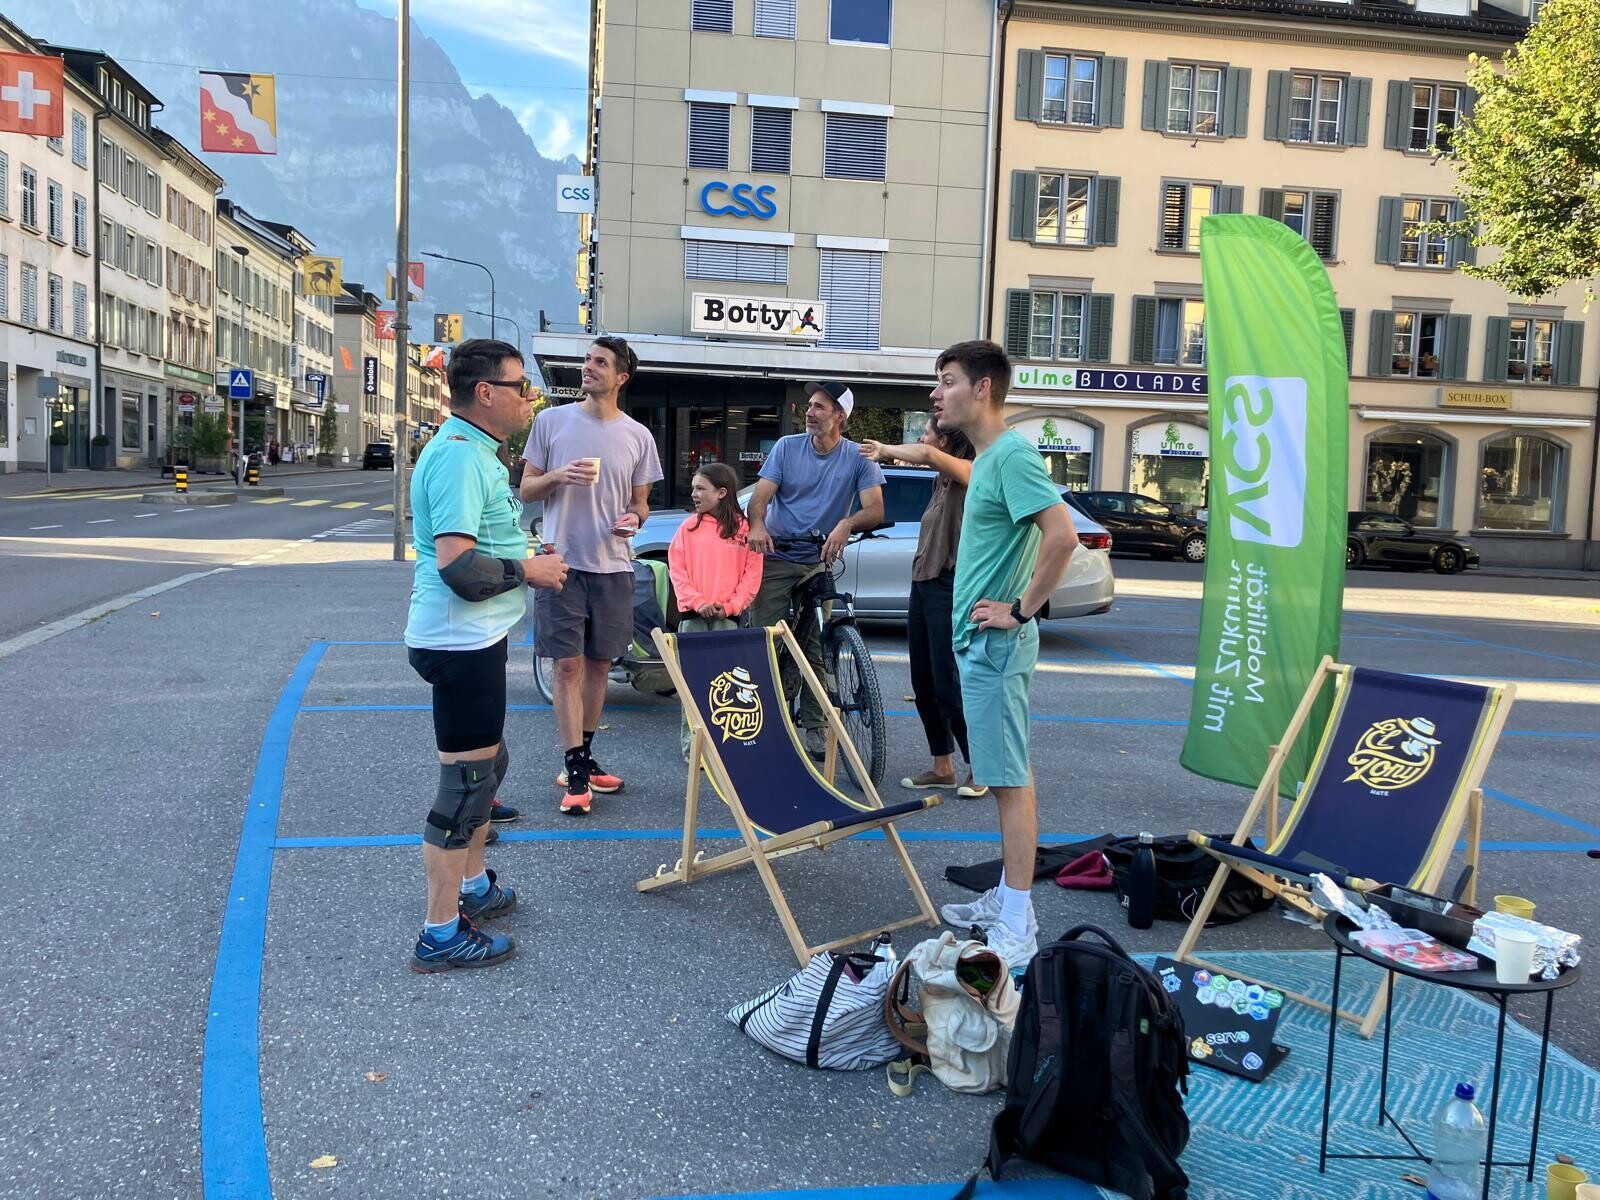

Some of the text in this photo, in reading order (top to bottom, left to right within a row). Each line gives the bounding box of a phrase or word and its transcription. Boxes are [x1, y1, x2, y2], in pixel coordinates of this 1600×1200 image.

[561, 187, 590, 200] CSS
[700, 181, 777, 220] CSS
[703, 299, 790, 330] Botty
[1019, 368, 1202, 391] ulme BIOLADE
[551, 387, 579, 397] Botty
[1448, 393, 1506, 404] SCHUH-BOX
[1038, 437, 1073, 446] ulme
[1160, 441, 1194, 451] ulme
[710, 678, 734, 706] El
[711, 706, 761, 743] Tony
[1365, 721, 1402, 750] El
[1343, 749, 1429, 783] Tony
[1205, 1031, 1250, 1045] servo
